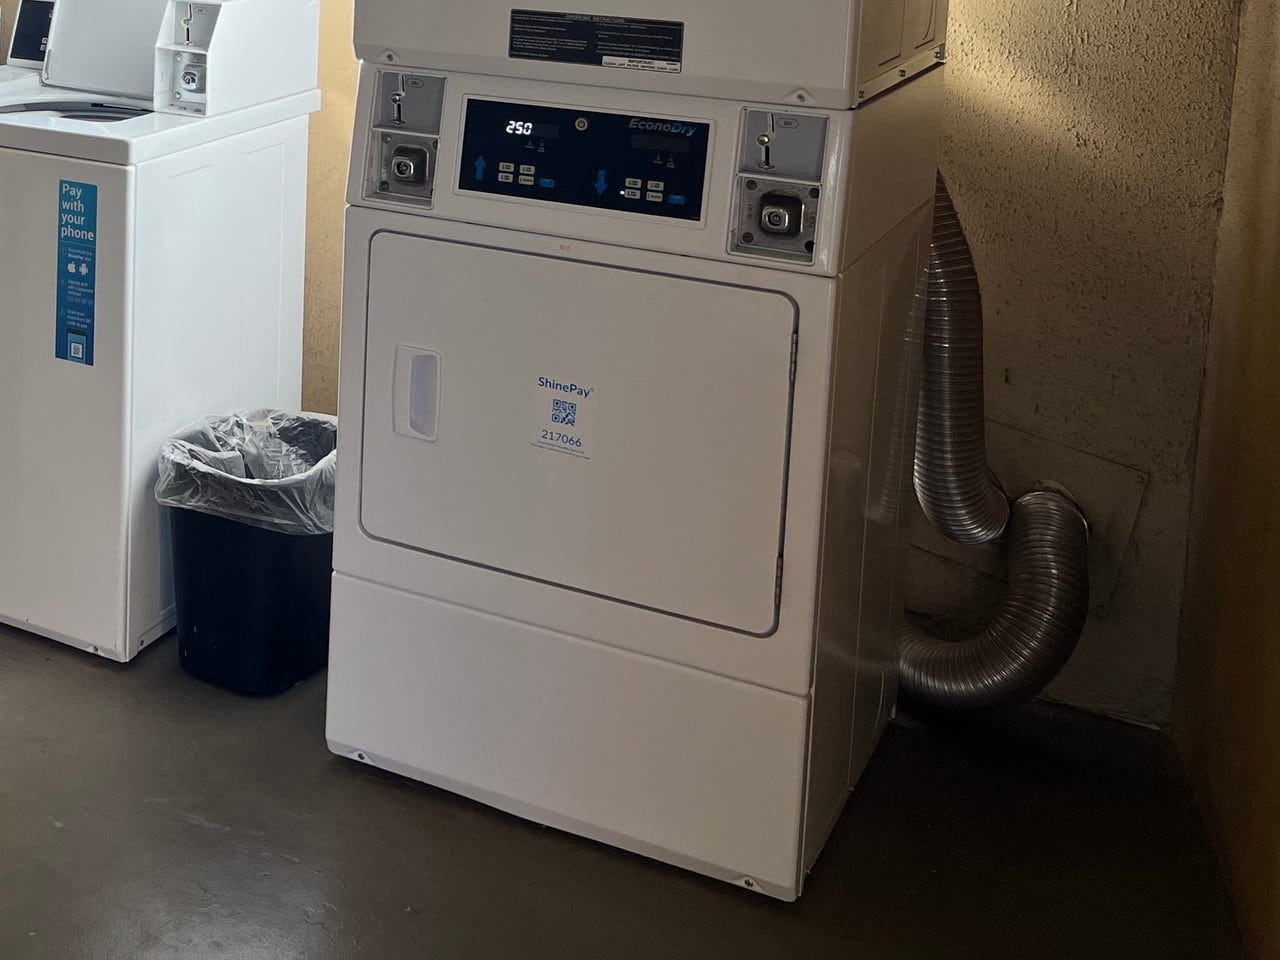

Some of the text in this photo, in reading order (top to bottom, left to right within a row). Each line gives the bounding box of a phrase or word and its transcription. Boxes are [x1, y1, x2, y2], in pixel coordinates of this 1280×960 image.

[505, 120, 534, 136] 250
[628, 118, 696, 137] EconoDry
[62, 183, 82, 199] Pay
[62, 199, 85, 213] with
[61, 212, 85, 226] your
[61, 225, 95, 241] phone
[538, 377, 590, 398] ShinePay
[541, 429, 582, 448] 217066
